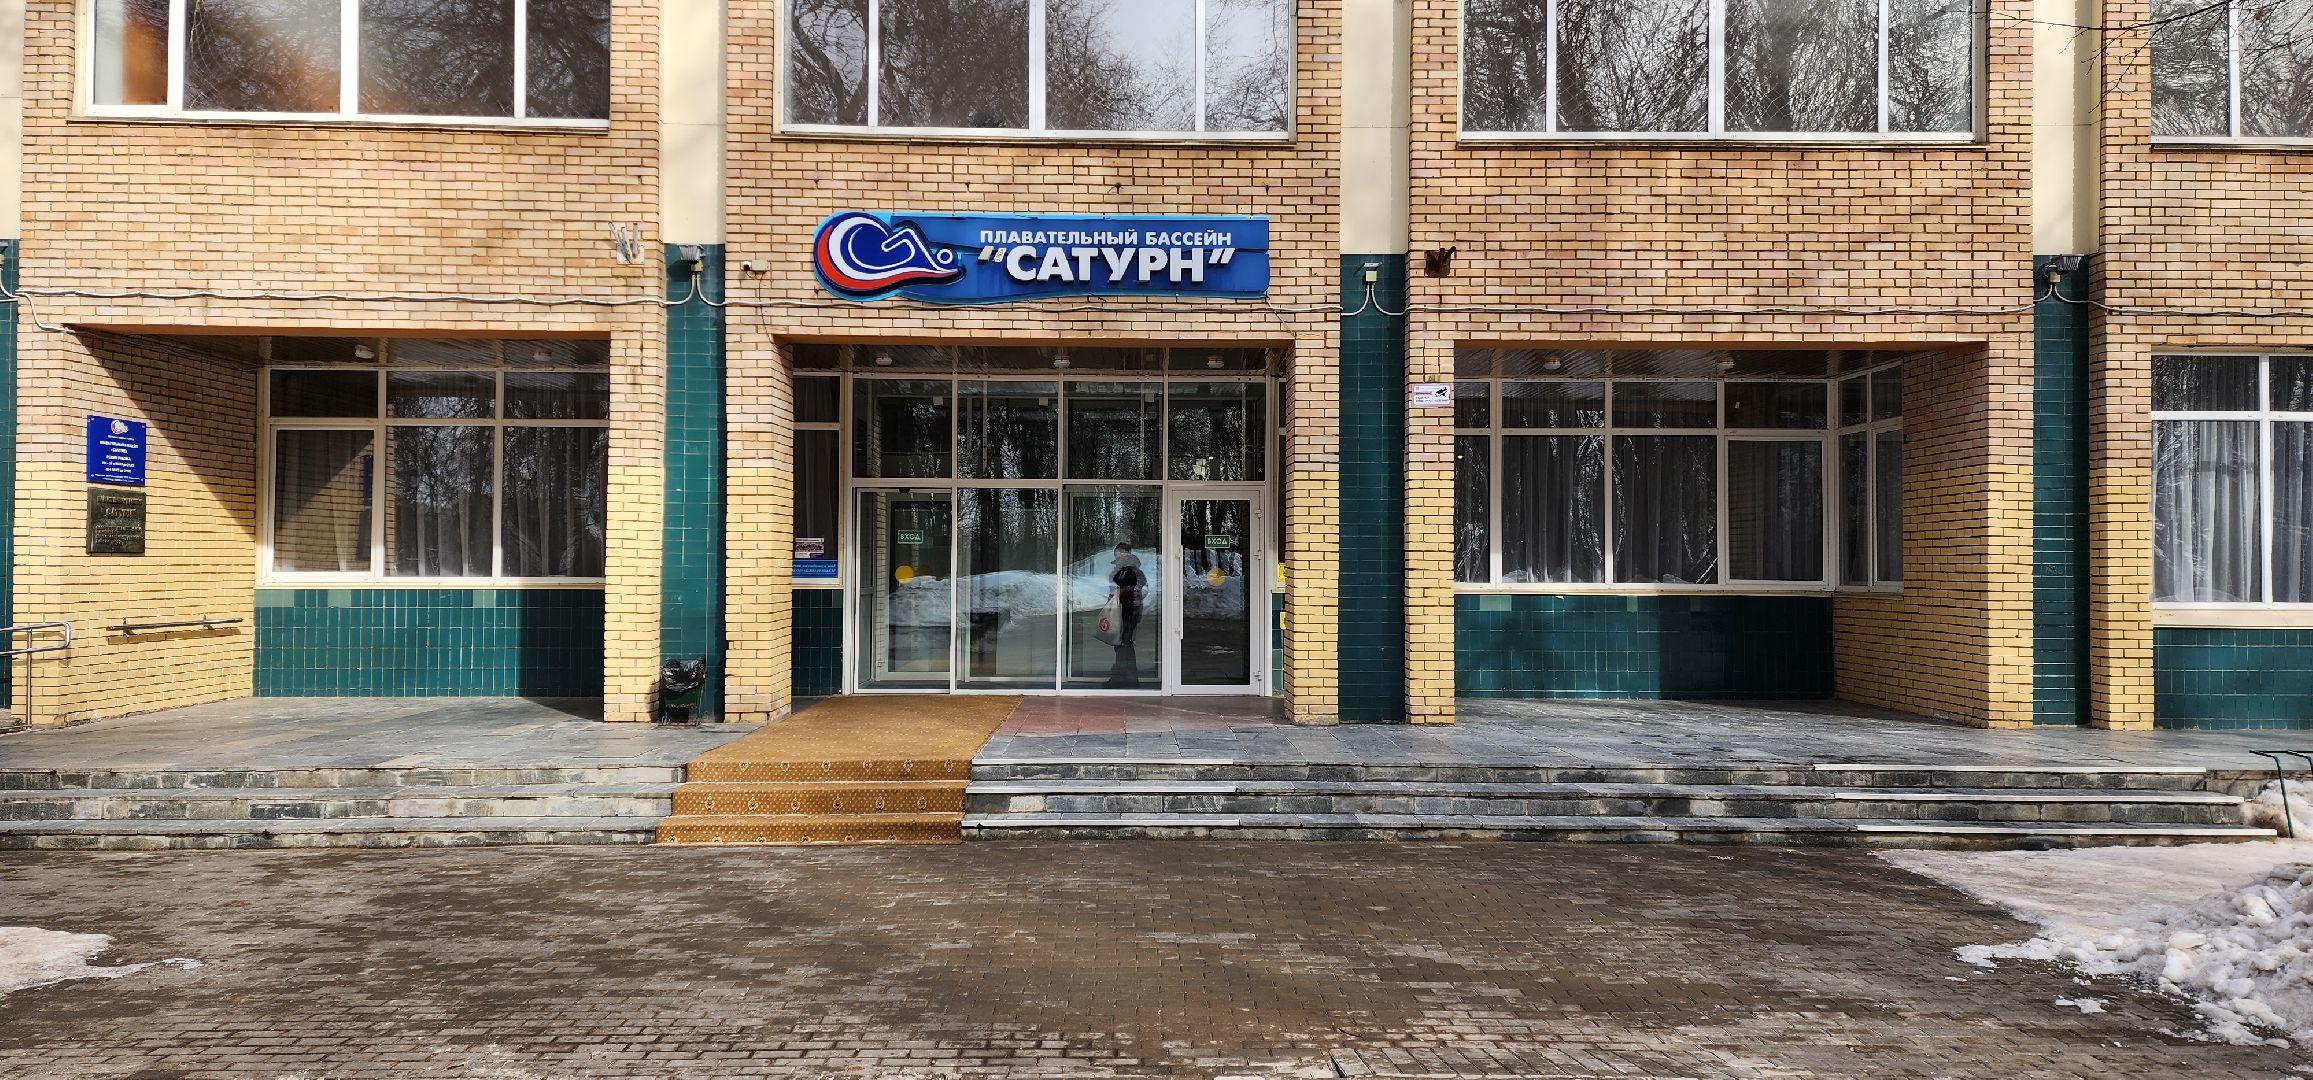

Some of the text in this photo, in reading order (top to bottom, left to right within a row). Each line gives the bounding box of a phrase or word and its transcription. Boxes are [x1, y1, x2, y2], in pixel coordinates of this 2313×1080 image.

[980, 229, 1232, 246] ПЛАВАТЕЛЬНЫЙ БАССЕЙН
[977, 245, 1236, 282] "САТУРН"
[900, 533, 921, 541] ВХОД
[1207, 537, 1228, 545] ВХОД
